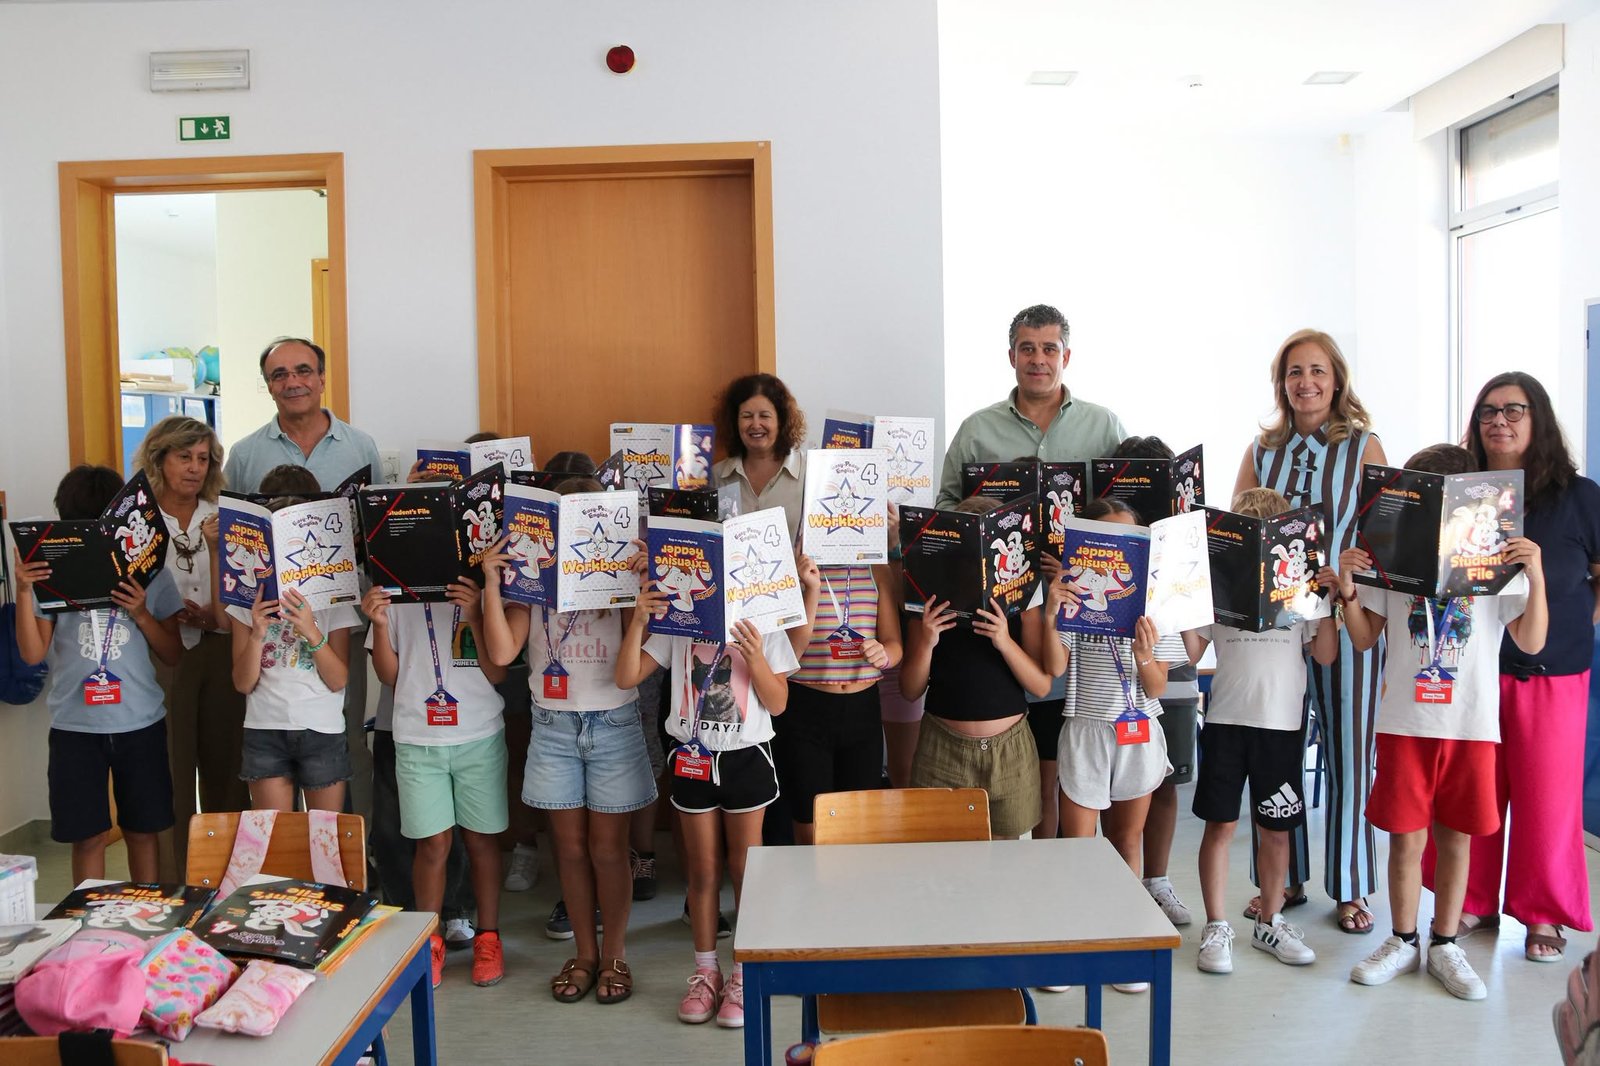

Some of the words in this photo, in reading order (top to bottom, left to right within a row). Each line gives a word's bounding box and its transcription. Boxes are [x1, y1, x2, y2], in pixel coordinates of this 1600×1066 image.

[831, 433, 861, 448] Reader
[912, 430, 927, 450] 4
[510, 449, 525, 468] 4
[622, 453, 671, 466] Workboo
[426, 463, 460, 473] Reader
[861, 463, 879, 485] 4
[886, 475, 931, 488] rkbook
[1073, 480, 1082, 496] 4
[136, 489, 147, 506] 4
[491, 483, 501, 501] 4
[1408, 491, 1421, 500] File
[1499, 490, 1514, 510] 4
[324, 512, 342, 534] 4
[514, 512, 550, 530] Reader
[614, 506, 630, 529] 4
[808, 514, 884, 529] Workbook
[1022, 511, 1033, 533] 4
[229, 523, 264, 541] Reader
[508, 522, 554, 544] Extensive
[763, 524, 781, 547] 4
[949, 531, 961, 539] File
[1232, 532, 1243, 540] File
[1305, 522, 1318, 541] 4
[224, 533, 269, 555] Extensive
[661, 544, 705, 559] Reader
[126, 533, 164, 576] Student's
[1076, 546, 1124, 561] Reader
[1450, 555, 1505, 569] Student'
[140, 554, 158, 574] File
[280, 559, 354, 585] Workbook
[654, 555, 710, 574] Extensive
[1069, 556, 1130, 575] Extensive
[223, 573, 237, 592] 4
[503, 567, 517, 586] 4
[1467, 568, 1494, 581] File
[726, 574, 797, 603] Workbook
[992, 570, 1035, 598] Student's
[1005, 589, 1023, 605] File
[557, 616, 592, 637] Set
[680, 718, 742, 733] FDAY!!
[1257, 800, 1303, 818] adidas
[85, 893, 185, 907] Student's
[121, 888, 163, 897] File
[250, 890, 346, 912] Student's
[285, 887, 326, 900] File
[210, 919, 238, 934] 4
